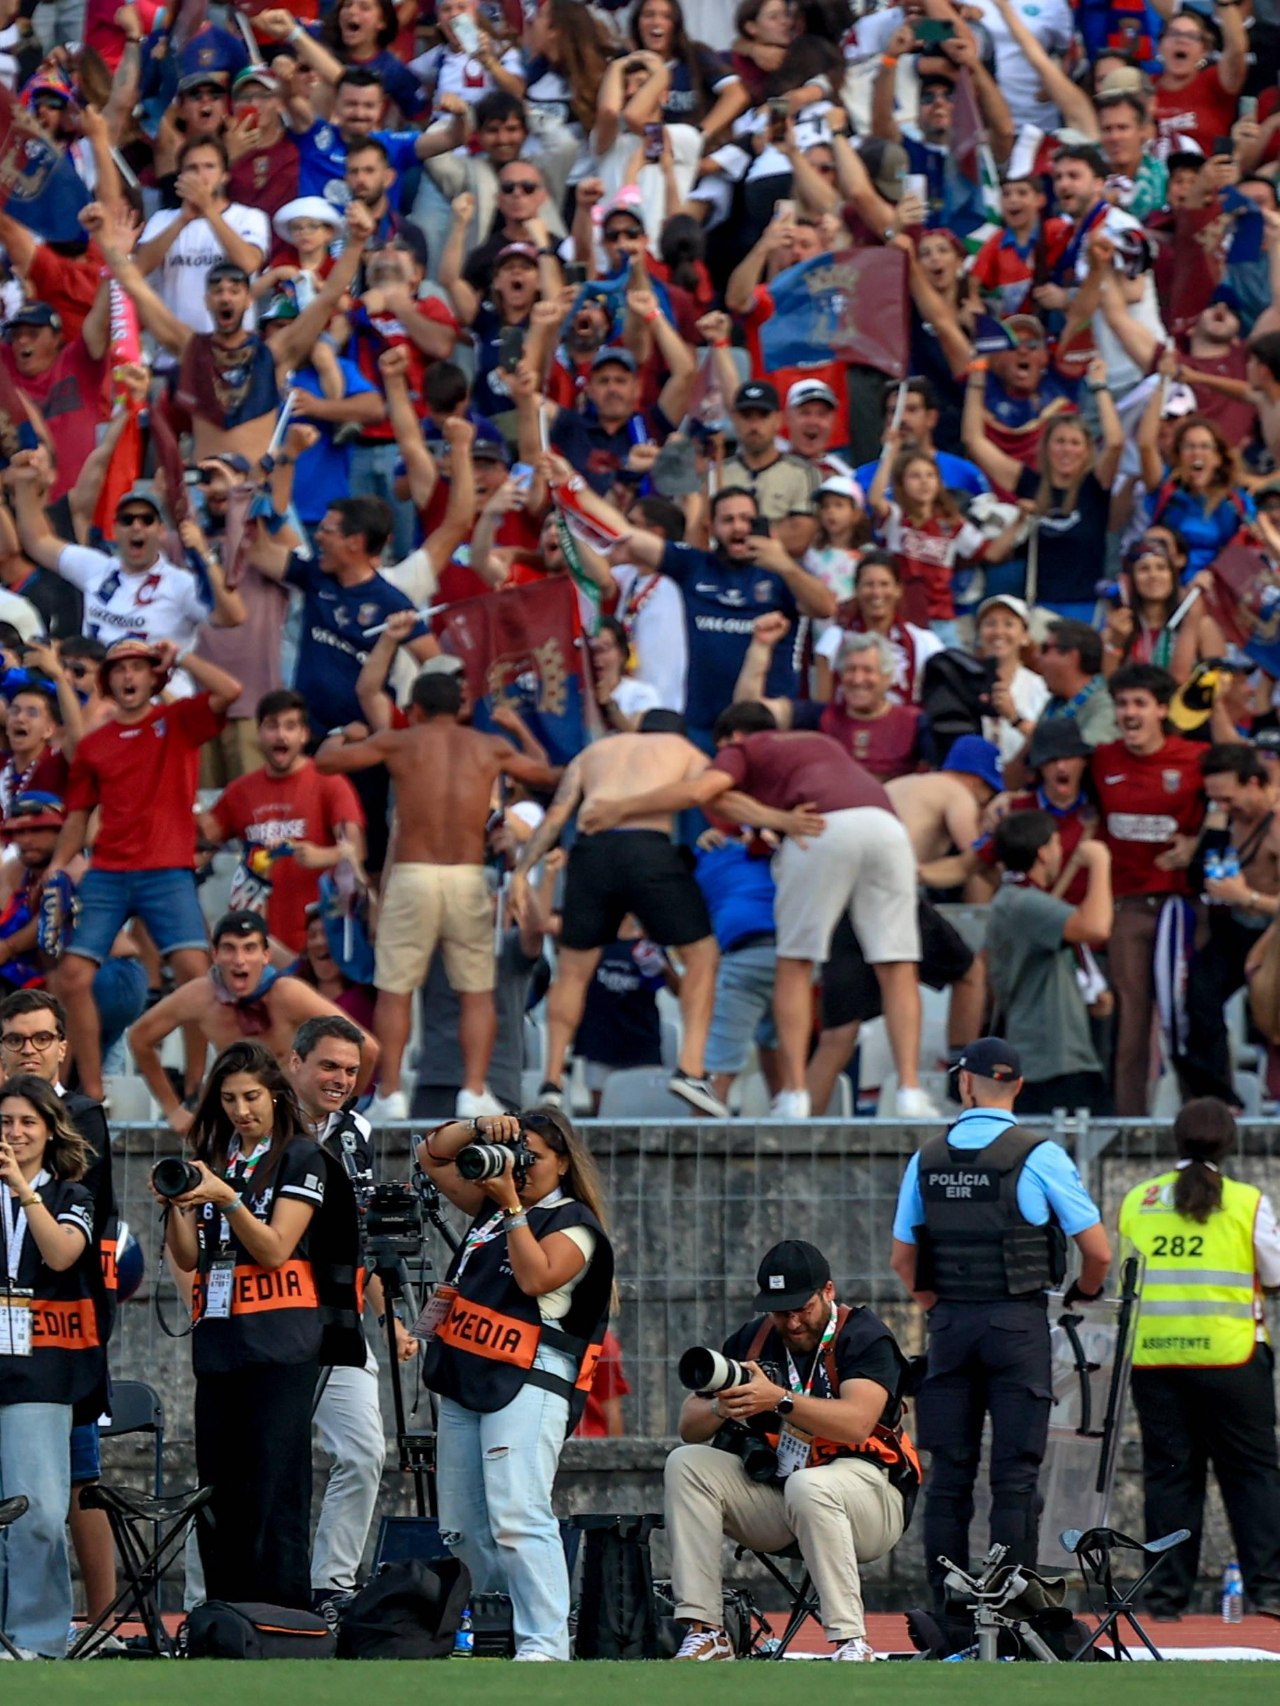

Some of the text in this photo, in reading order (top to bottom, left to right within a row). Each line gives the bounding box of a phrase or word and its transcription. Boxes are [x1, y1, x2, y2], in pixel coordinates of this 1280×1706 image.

[929, 1172, 990, 1187] POLÍCIA
[946, 1187, 972, 1199] EIR
[1152, 1236, 1204, 1258] 282
[233, 1269, 303, 1304] EDIA
[32, 1310, 83, 1339] EDIA
[445, 1310, 523, 1354] MEDIA
[1142, 1337, 1212, 1350] ASSISTENTE
